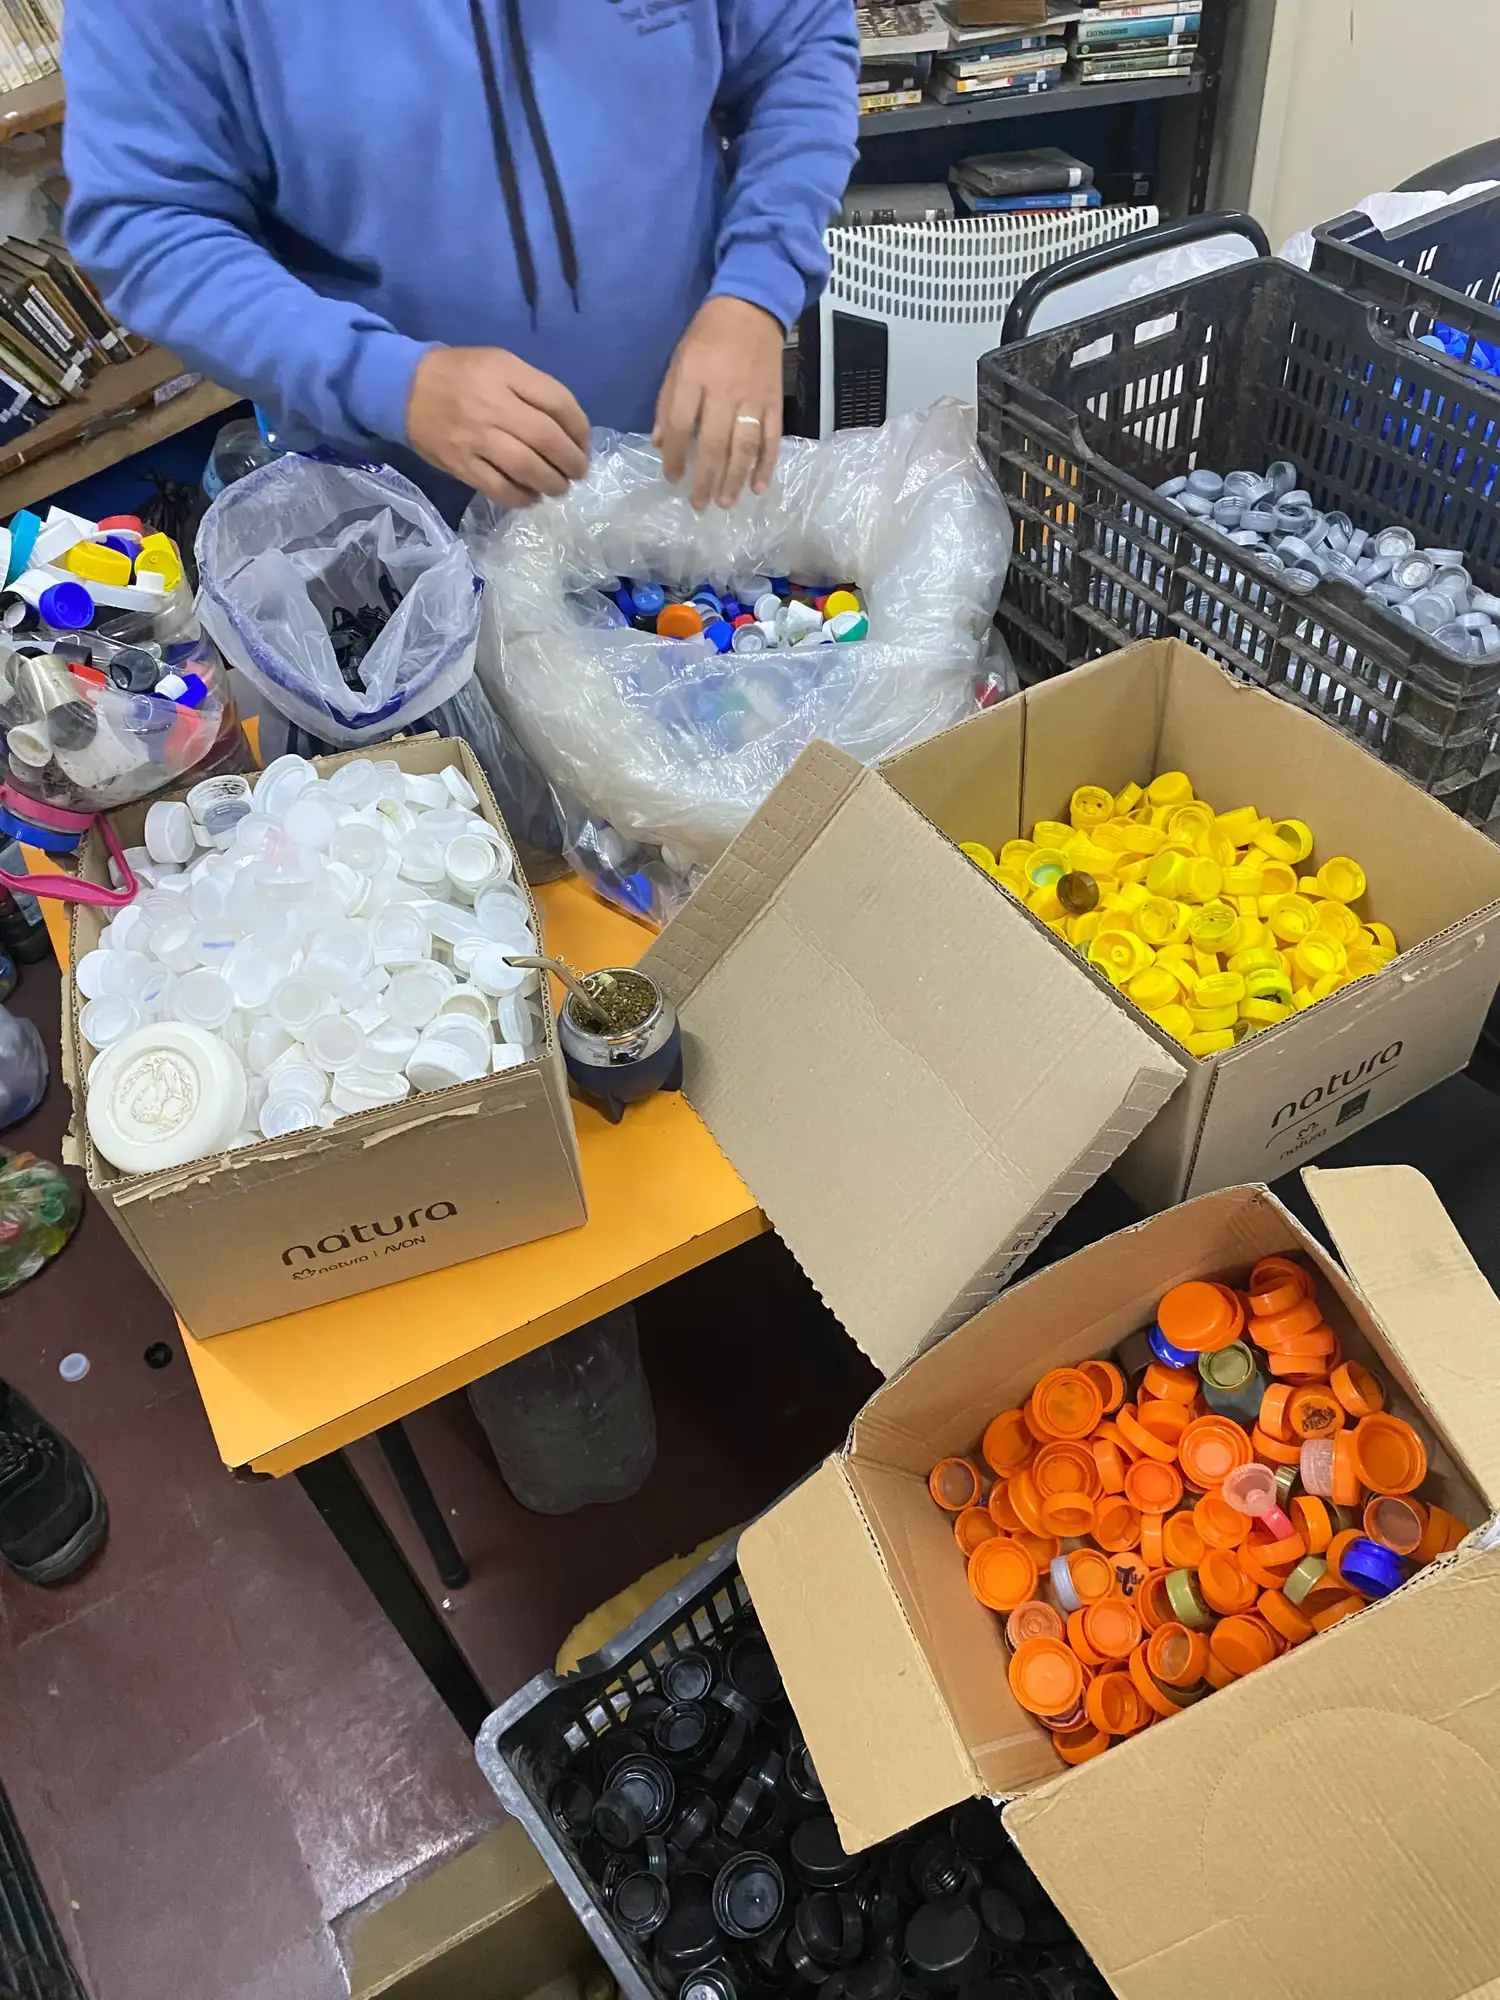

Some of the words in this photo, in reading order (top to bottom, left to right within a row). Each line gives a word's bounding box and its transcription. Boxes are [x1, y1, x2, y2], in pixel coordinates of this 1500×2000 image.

[1271, 1040, 1403, 1129] natura
[281, 1201, 458, 1266] natura
[318, 1255, 369, 1274] natura
[384, 1235, 426, 1255] AVON
